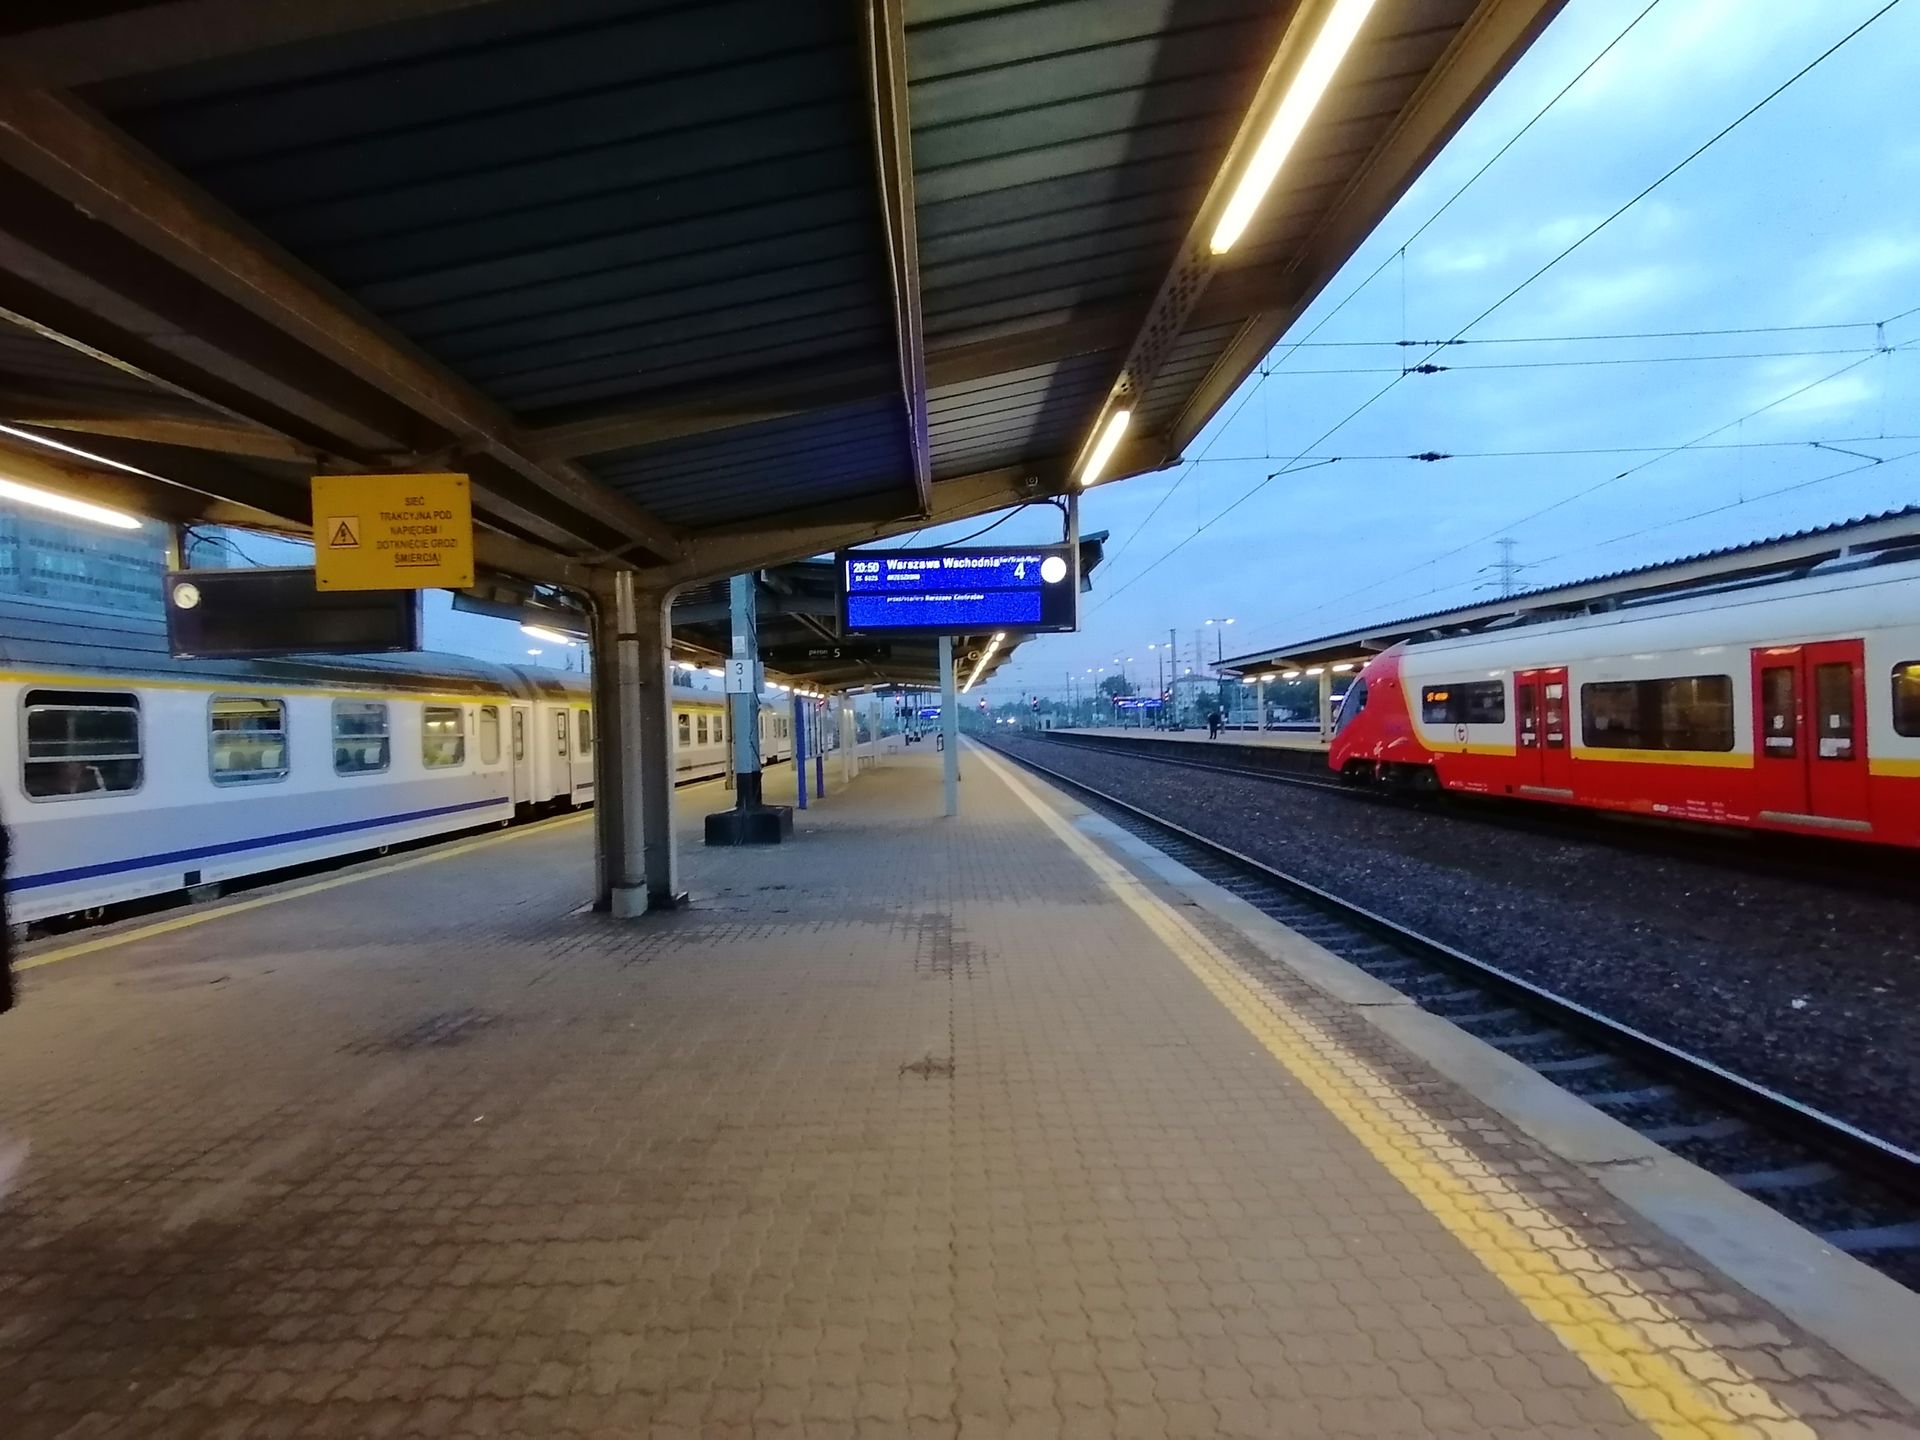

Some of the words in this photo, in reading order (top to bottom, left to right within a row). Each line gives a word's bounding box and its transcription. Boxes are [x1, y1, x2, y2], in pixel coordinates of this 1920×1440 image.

[380, 511, 432, 521] TRAKCYJNA
[434, 510, 452, 520] POD
[853, 562, 880, 573] 20:50
[886, 559, 940, 570] Warszawa
[942, 557, 1000, 569] Wschodnia
[1013, 562, 1026, 580] 4
[808, 649, 828, 657] peron
[833, 648, 841, 658] 5
[735, 662, 744, 675] 3
[738, 678, 742, 691] 1
